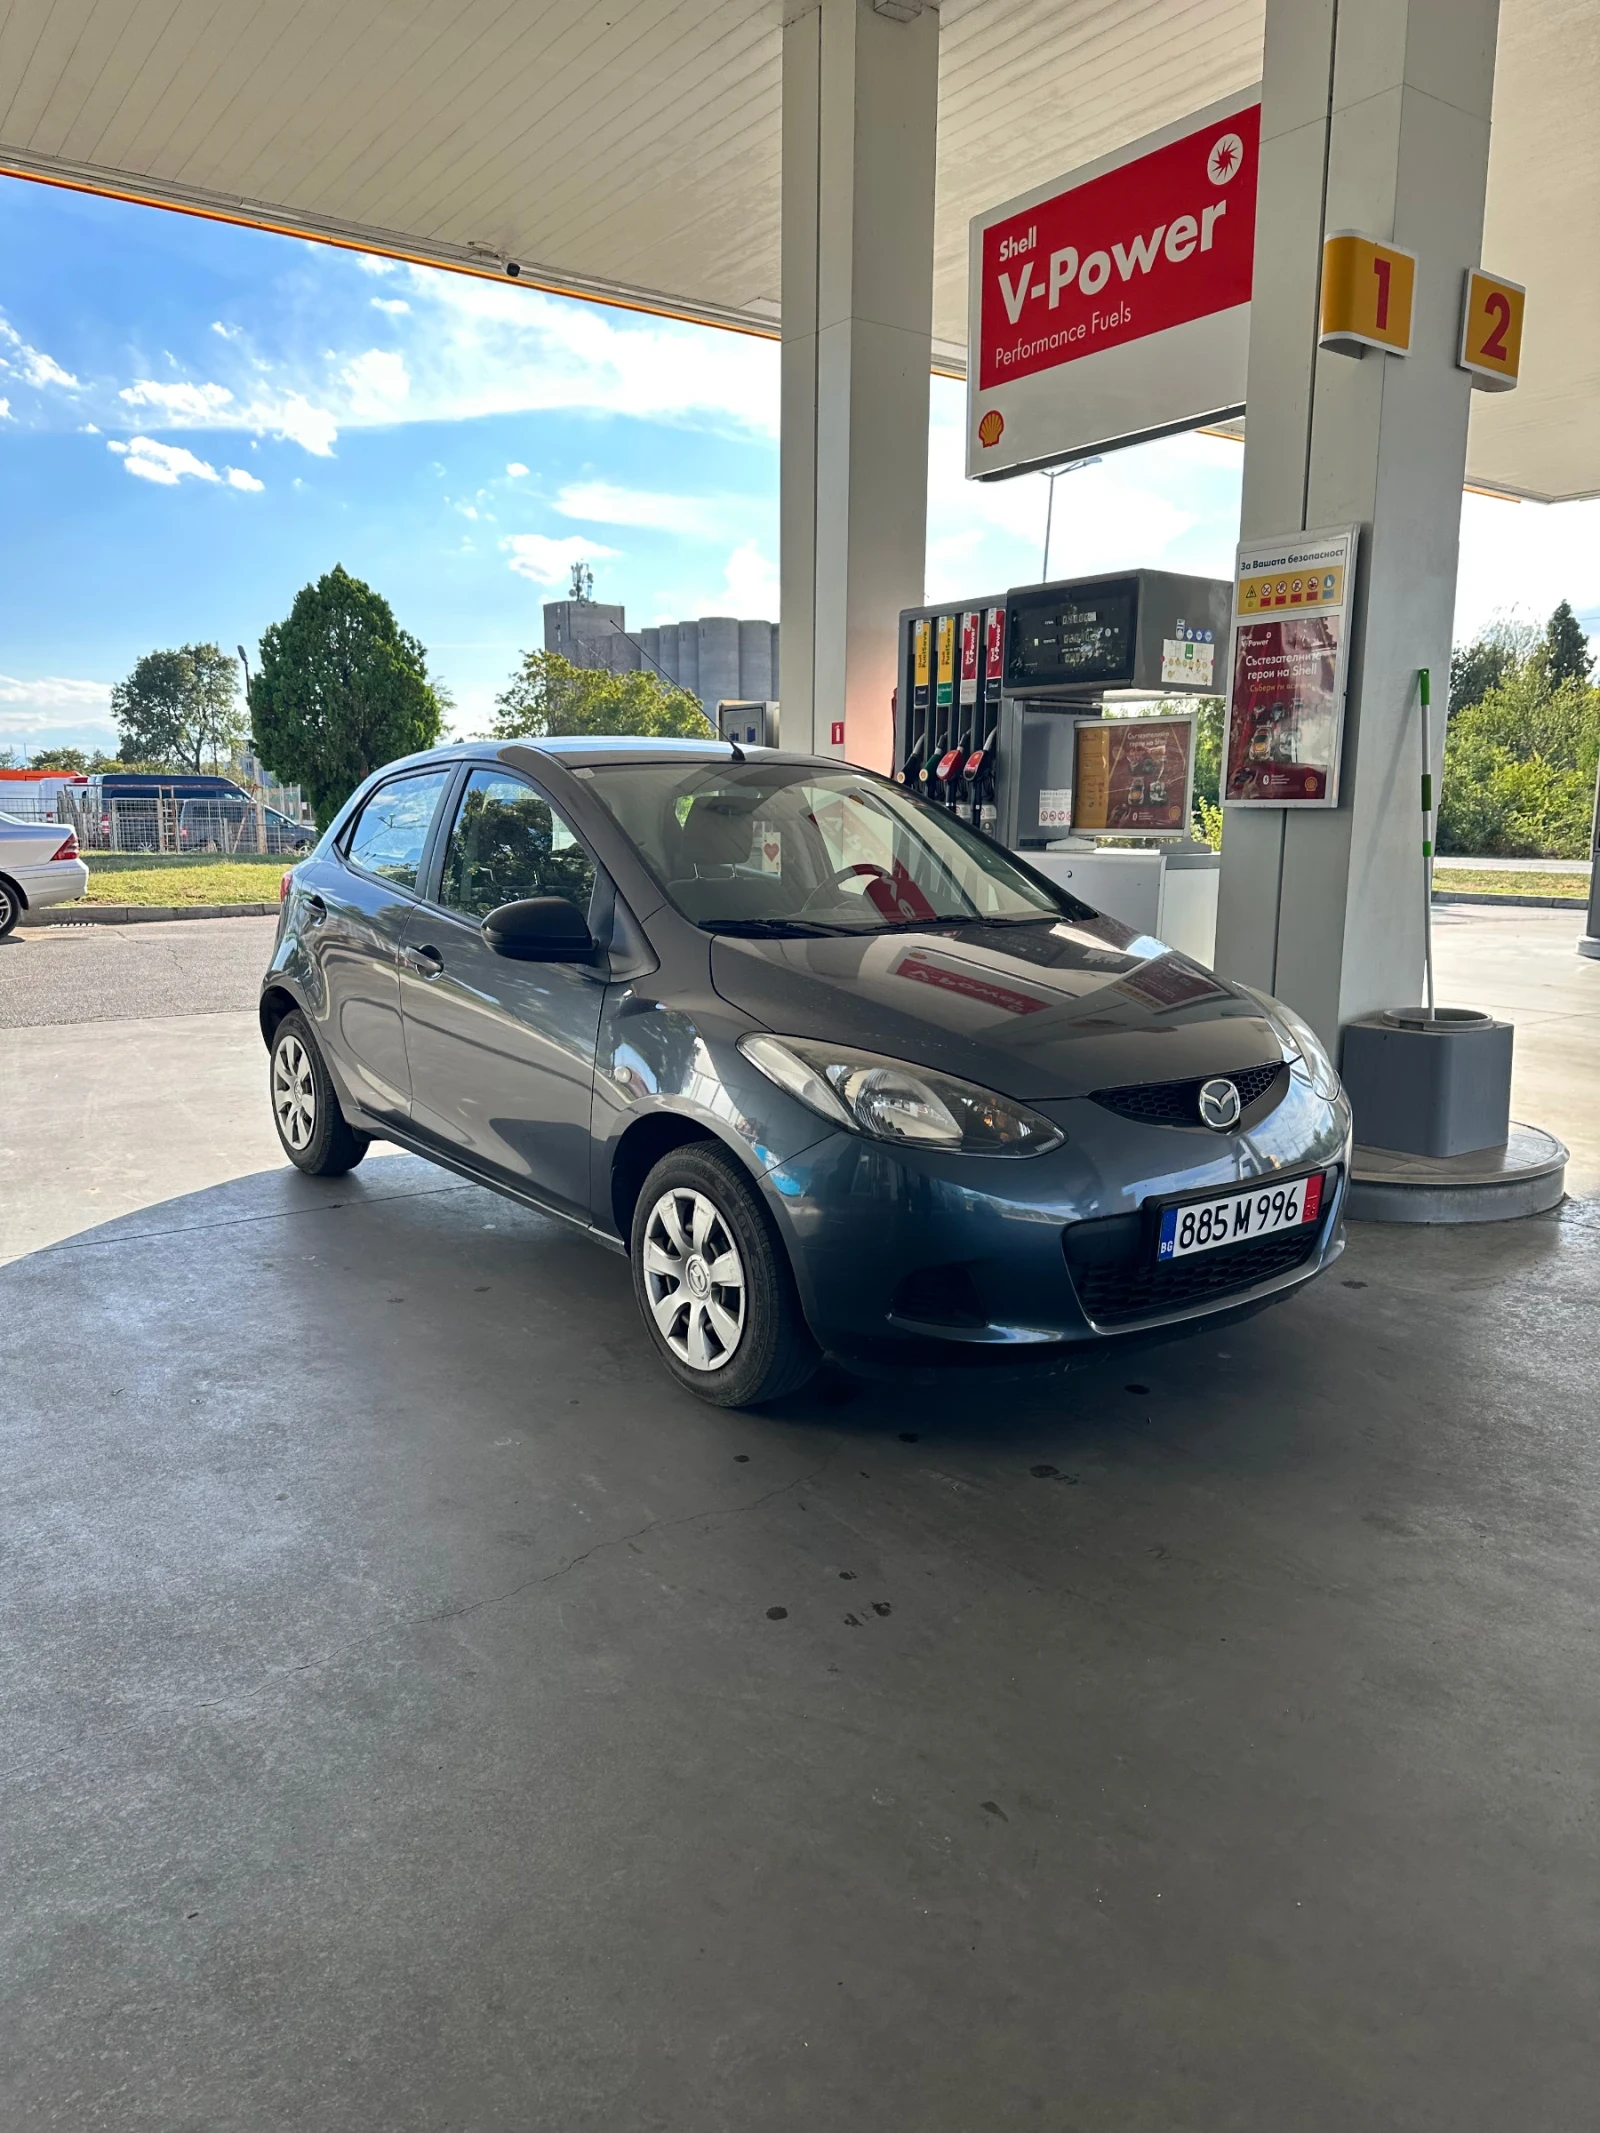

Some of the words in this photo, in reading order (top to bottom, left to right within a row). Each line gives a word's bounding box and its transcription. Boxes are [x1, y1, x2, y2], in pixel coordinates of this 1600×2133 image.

[998, 200, 1227, 325] V-Power
[999, 226, 1037, 262] Shell
[1374, 257, 1391, 331] 1
[995, 323, 1087, 368] Performance
[1091, 301, 1132, 334] Fuels
[1480, 292, 1511, 361] 2
[1240, 562, 1251, 571] За
[1252, 557, 1286, 569] Вашата
[1287, 549, 1345, 564] безопасност
[1245, 652, 1322, 666] Състезателните
[1247, 671, 1275, 682] герои
[1277, 668, 1290, 677] на
[1292, 663, 1318, 676] Shell
[1179, 1203, 1229, 1249] 885
[1233, 1198, 1252, 1237] M
[1257, 1186, 1298, 1230] 996
[1160, 1240, 1174, 1254] BG
